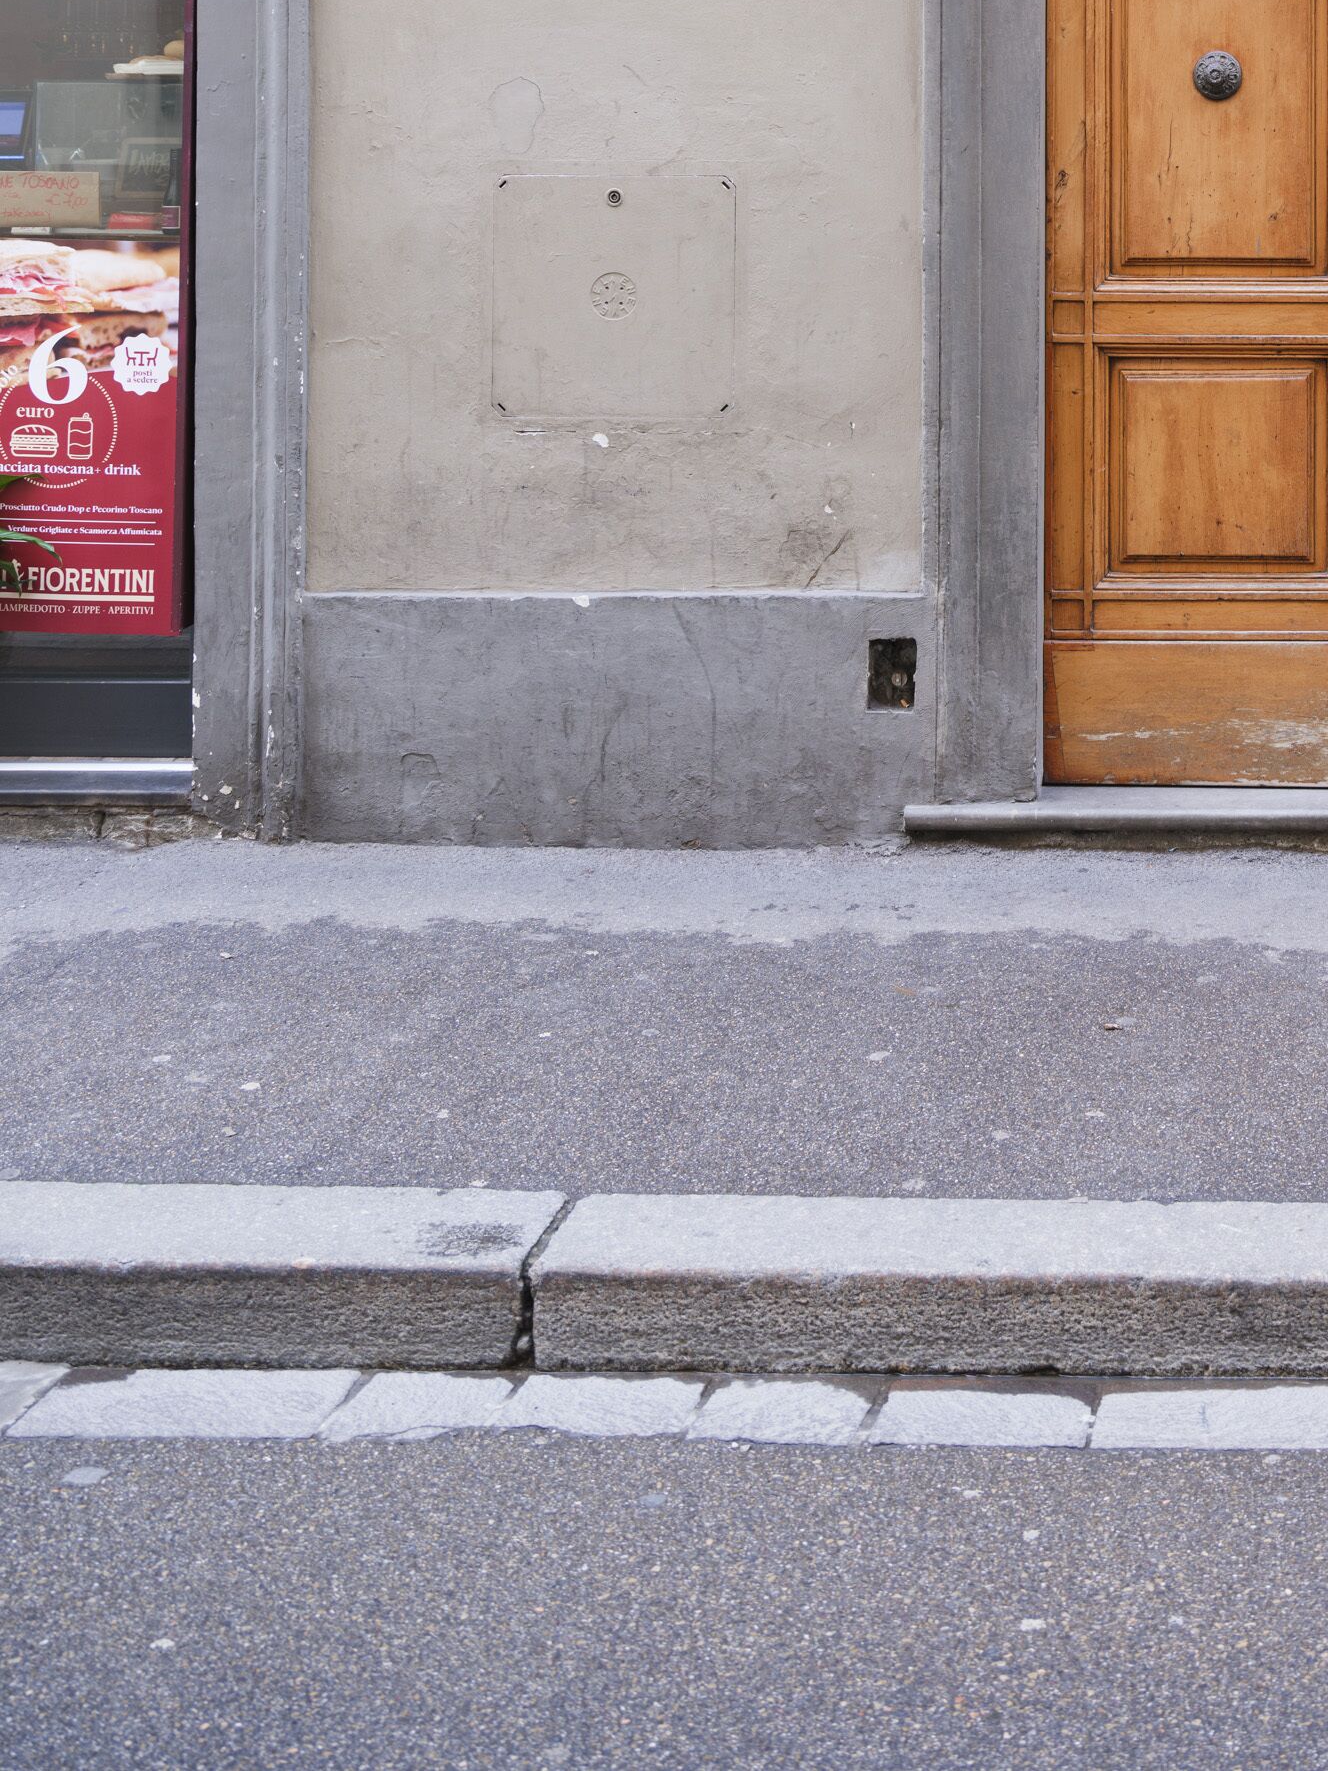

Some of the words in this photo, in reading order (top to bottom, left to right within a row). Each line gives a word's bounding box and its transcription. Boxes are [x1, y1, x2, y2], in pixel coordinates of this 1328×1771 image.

[28, 323, 89, 405] 6
[16, 406, 55, 418] euro
[104, 464, 142, 476] drink
[0, 502, 41, 512] Prosciutto
[41, 503, 67, 513] Crudo
[67, 504, 85, 515] Dop
[92, 505, 128, 514] Pecorino
[129, 506, 163, 515] Toscano
[8, 524, 38, 534] Verdure
[39, 525, 73, 535] Grigliate
[79, 526, 118, 535] Scamorza
[118, 527, 163, 536] Affumicata
[28, 566, 155, 594] FIORENTINI
[0, 603, 66, 614] LAMPREDOTTO
[72, 605, 101, 615] ZUPPE
[108, 606, 154, 616] APERITIVI
